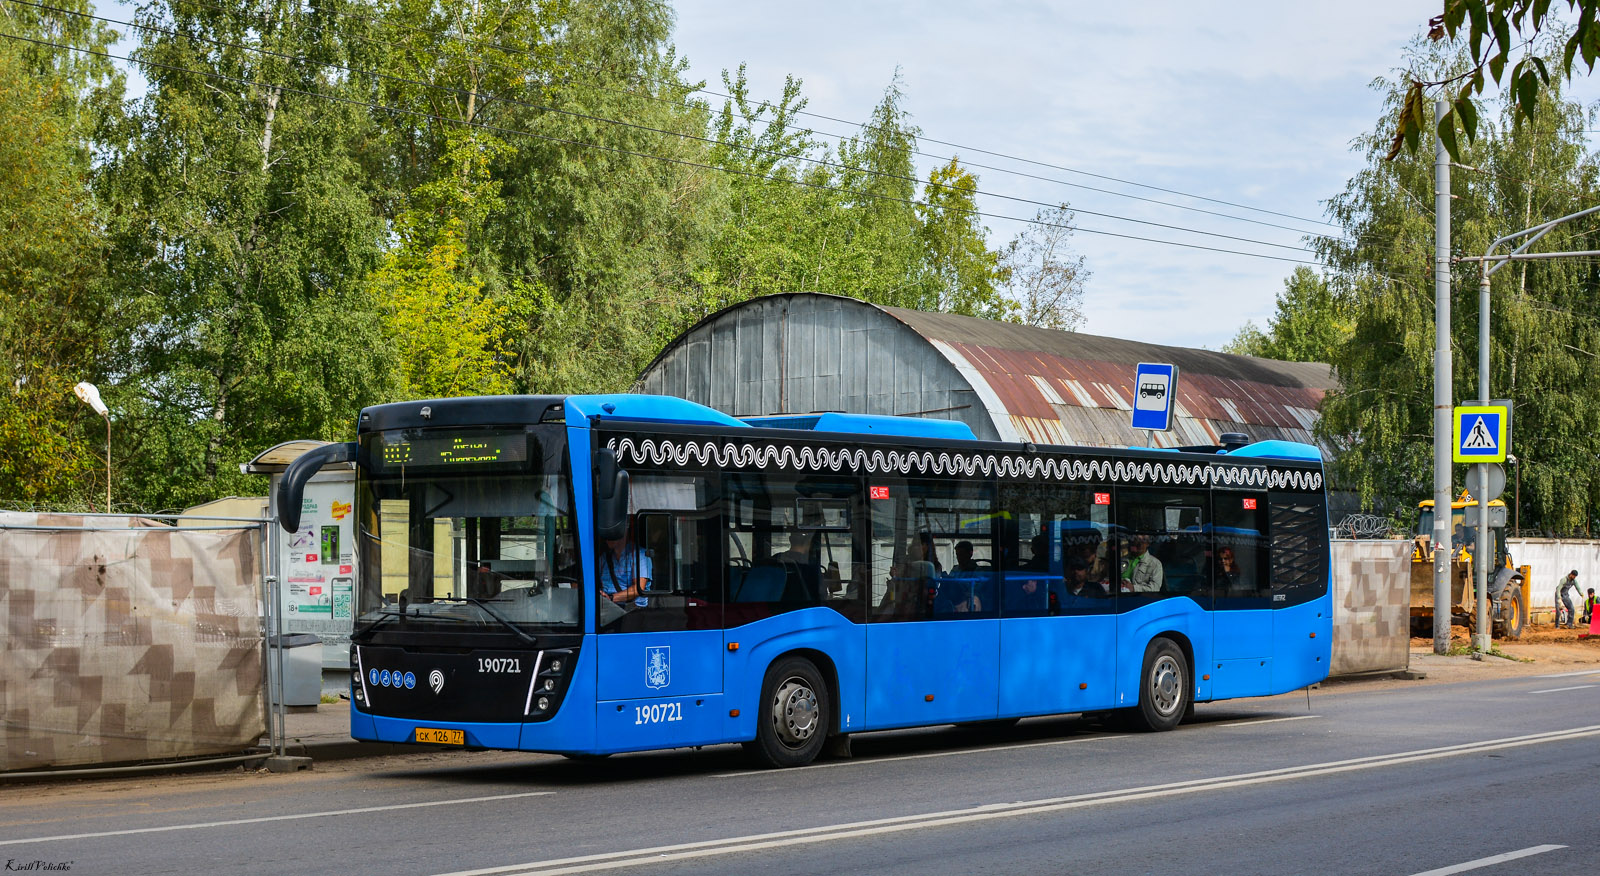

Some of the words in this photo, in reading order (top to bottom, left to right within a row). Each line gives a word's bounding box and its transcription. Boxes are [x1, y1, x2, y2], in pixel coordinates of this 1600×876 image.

[288, 604, 298, 612] 18+
[478, 658, 522, 673] 190721
[635, 702, 683, 725] 190721
[433, 730, 449, 742] 126
[452, 730, 462, 740] 77
